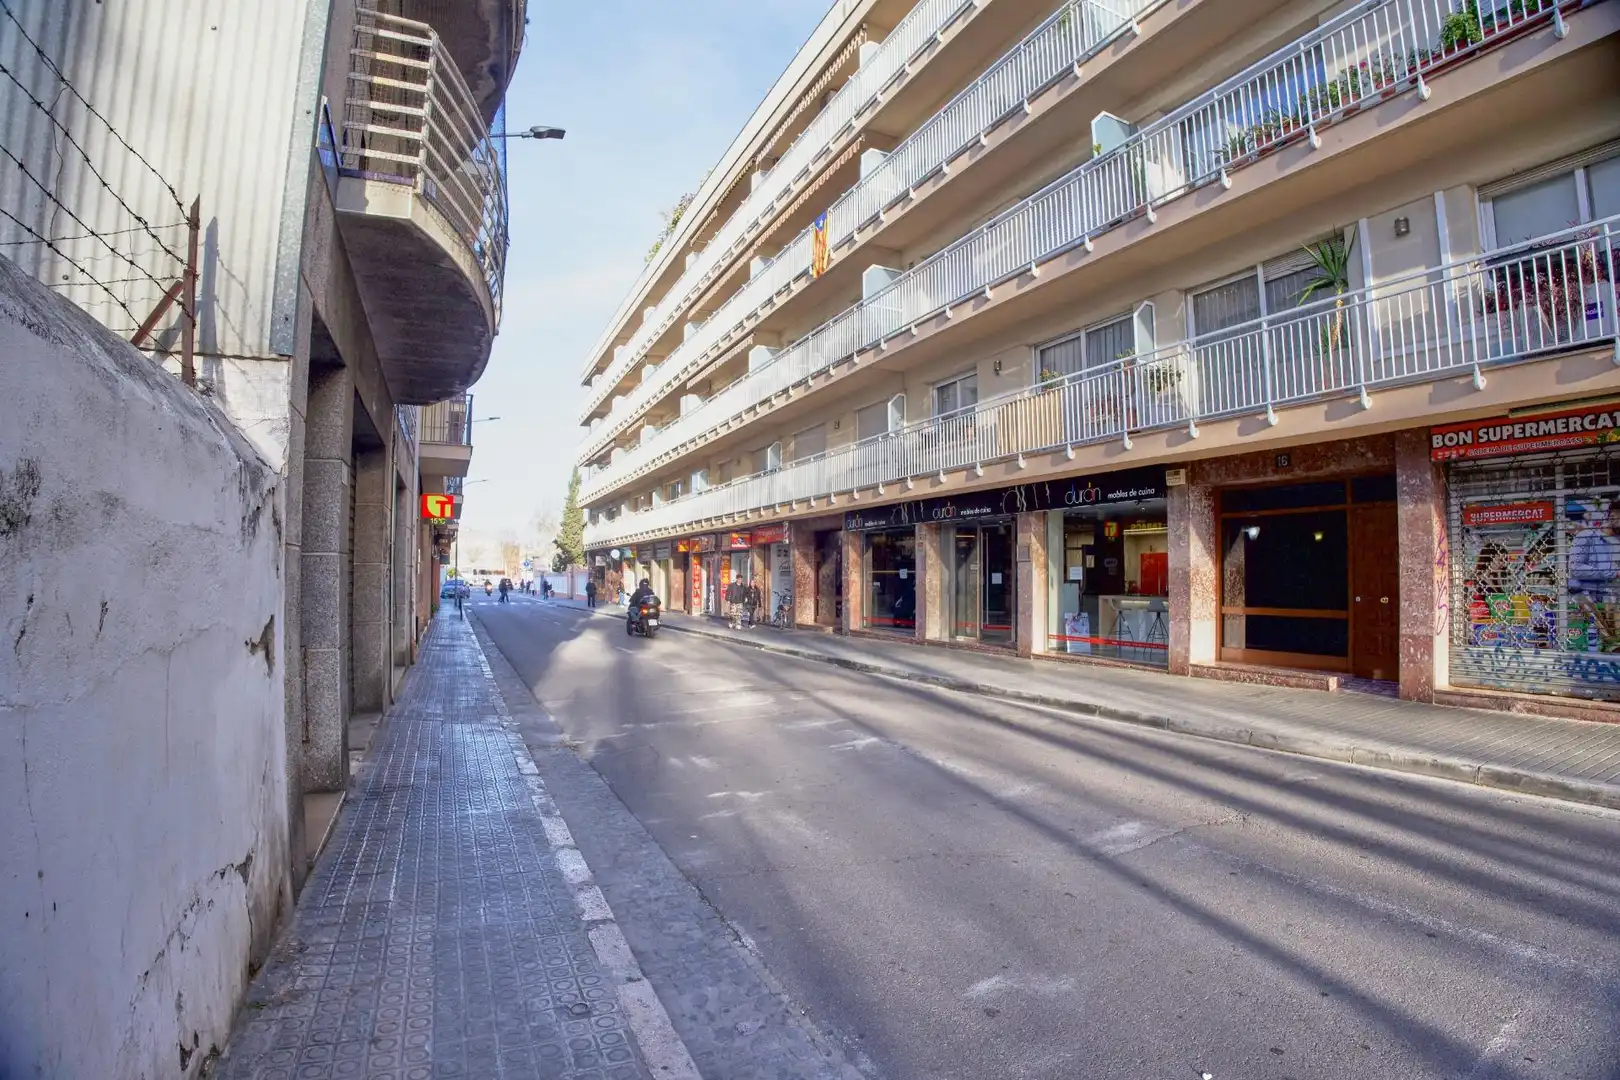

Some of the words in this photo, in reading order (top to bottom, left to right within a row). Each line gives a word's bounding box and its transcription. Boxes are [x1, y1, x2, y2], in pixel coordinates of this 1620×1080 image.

[1432, 430, 1473, 449] BON
[1478, 411, 1620, 443] SUPERMERCAT
[1278, 455, 1288, 466] 16
[1107, 489, 1128, 499] mobles
[1129, 488, 1137, 497] de
[1138, 486, 1155, 496] cuina
[1470, 508, 1544, 522] SUPERMERCAT
